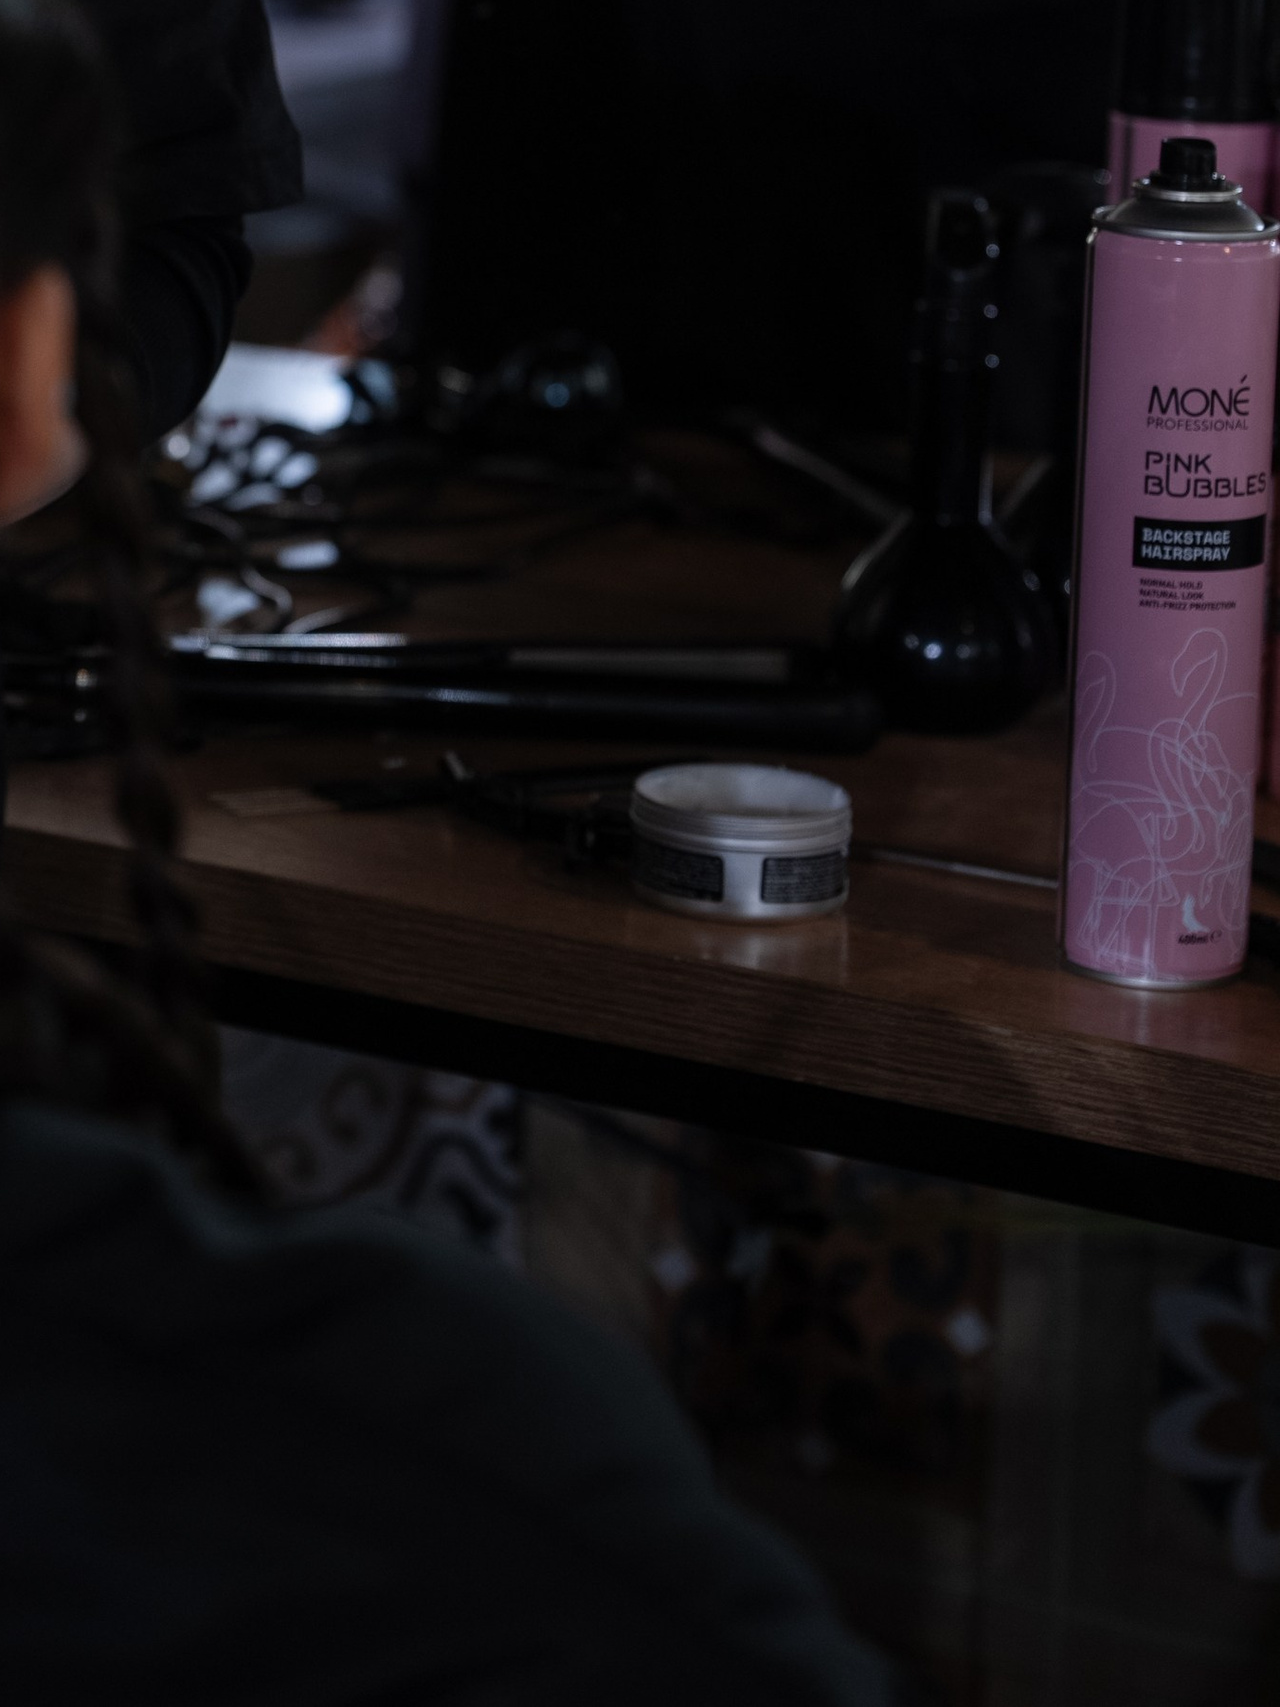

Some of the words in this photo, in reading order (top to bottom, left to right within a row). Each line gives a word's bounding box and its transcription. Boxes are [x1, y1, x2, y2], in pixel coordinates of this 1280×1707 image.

[1147, 374, 1251, 417] MONÉ
[1146, 416, 1249, 432] PROFESSIONAL
[1144, 471, 1267, 499] BUBBLES
[1141, 527, 1231, 545] BACKSTAGE
[1140, 544, 1231, 562] HAIRSPRAY
